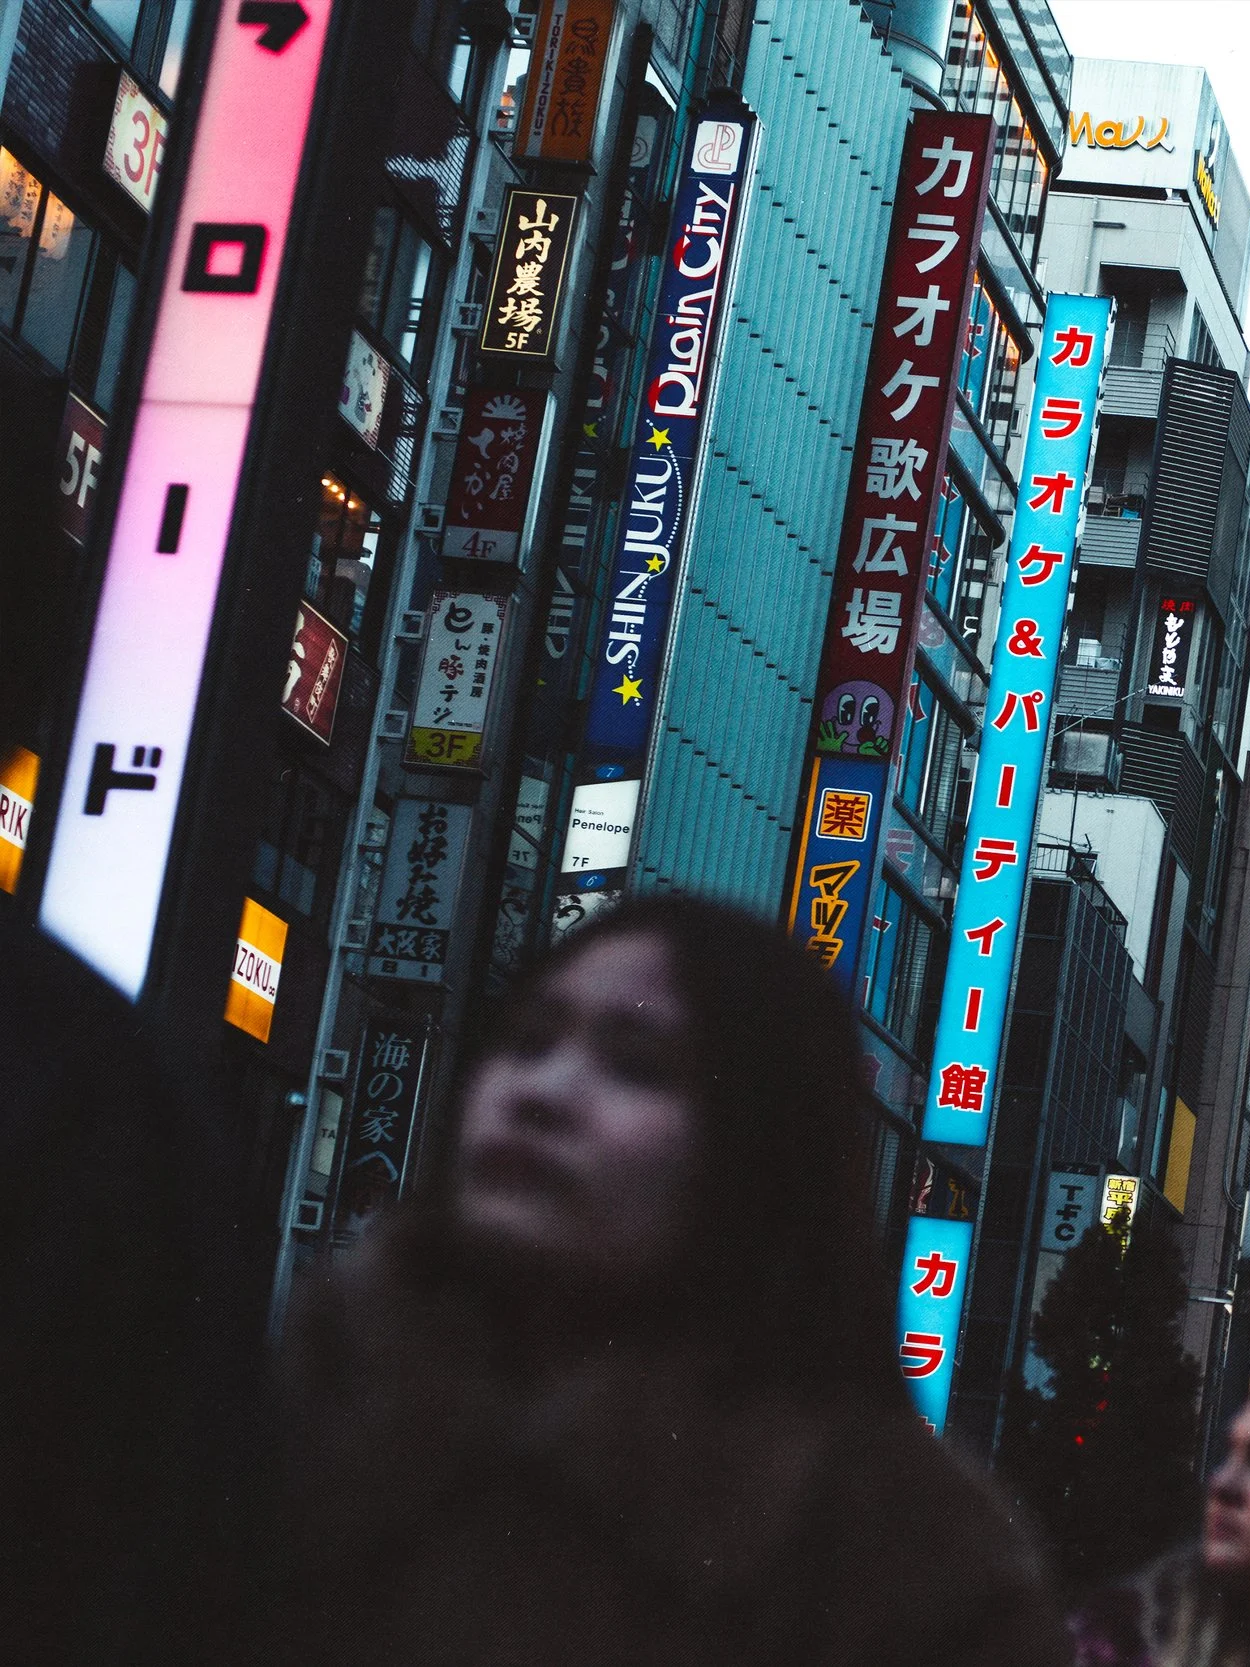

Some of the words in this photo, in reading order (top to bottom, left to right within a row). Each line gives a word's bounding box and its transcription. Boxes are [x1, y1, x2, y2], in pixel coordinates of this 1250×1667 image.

[534, 14, 563, 132] TORIKIZOKU
[498, 198, 559, 333] 山内農場
[505, 332, 530, 350] 5F
[841, 135, 974, 655] カラオケ歌広場
[59, 430, 101, 509] 5F
[462, 530, 497, 558] 4F
[606, 456, 673, 668] SHINJUKU
[1148, 684, 1185, 697] YAKINIKU
[425, 732, 467, 759] 3F
[572, 818, 630, 835] Penelope
[824, 794, 865, 836] 薬
[572, 857, 589, 868] 7F
